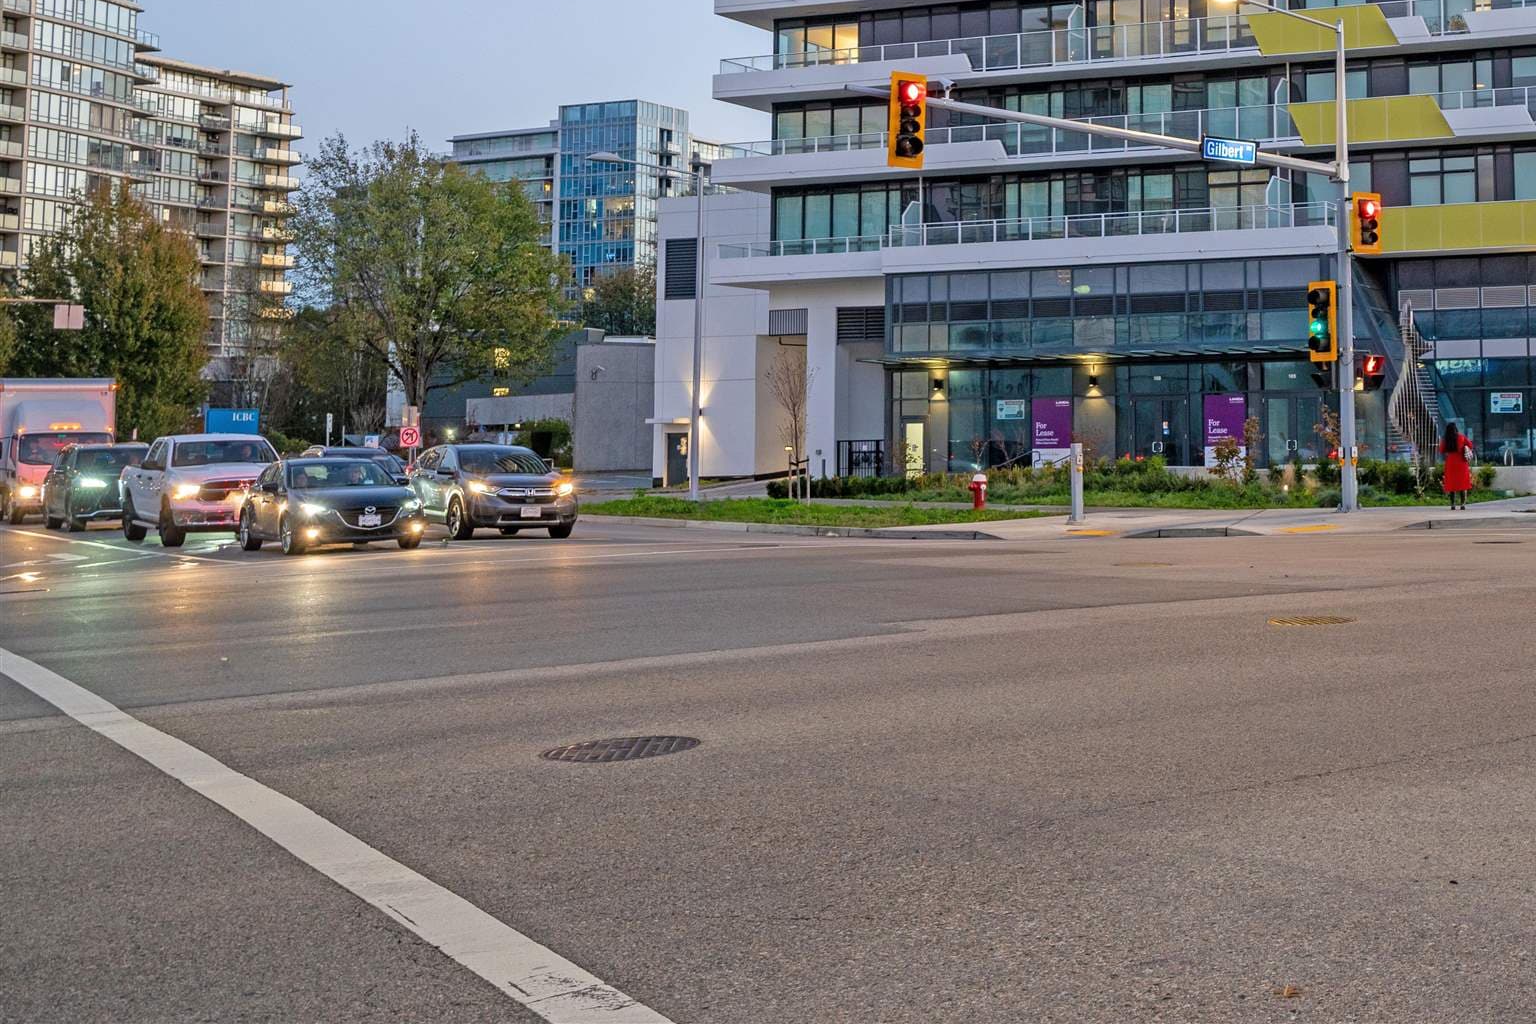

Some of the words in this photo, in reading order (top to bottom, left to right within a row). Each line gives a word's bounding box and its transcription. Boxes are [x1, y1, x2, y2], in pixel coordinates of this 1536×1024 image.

[1207, 141, 1244, 159] Gilbert
[232, 412, 255, 422] ICBC
[1035, 421, 1048, 429] For
[1208, 418, 1220, 426] For
[1035, 429, 1054, 437] Lease
[1208, 426, 1228, 434] Lease
